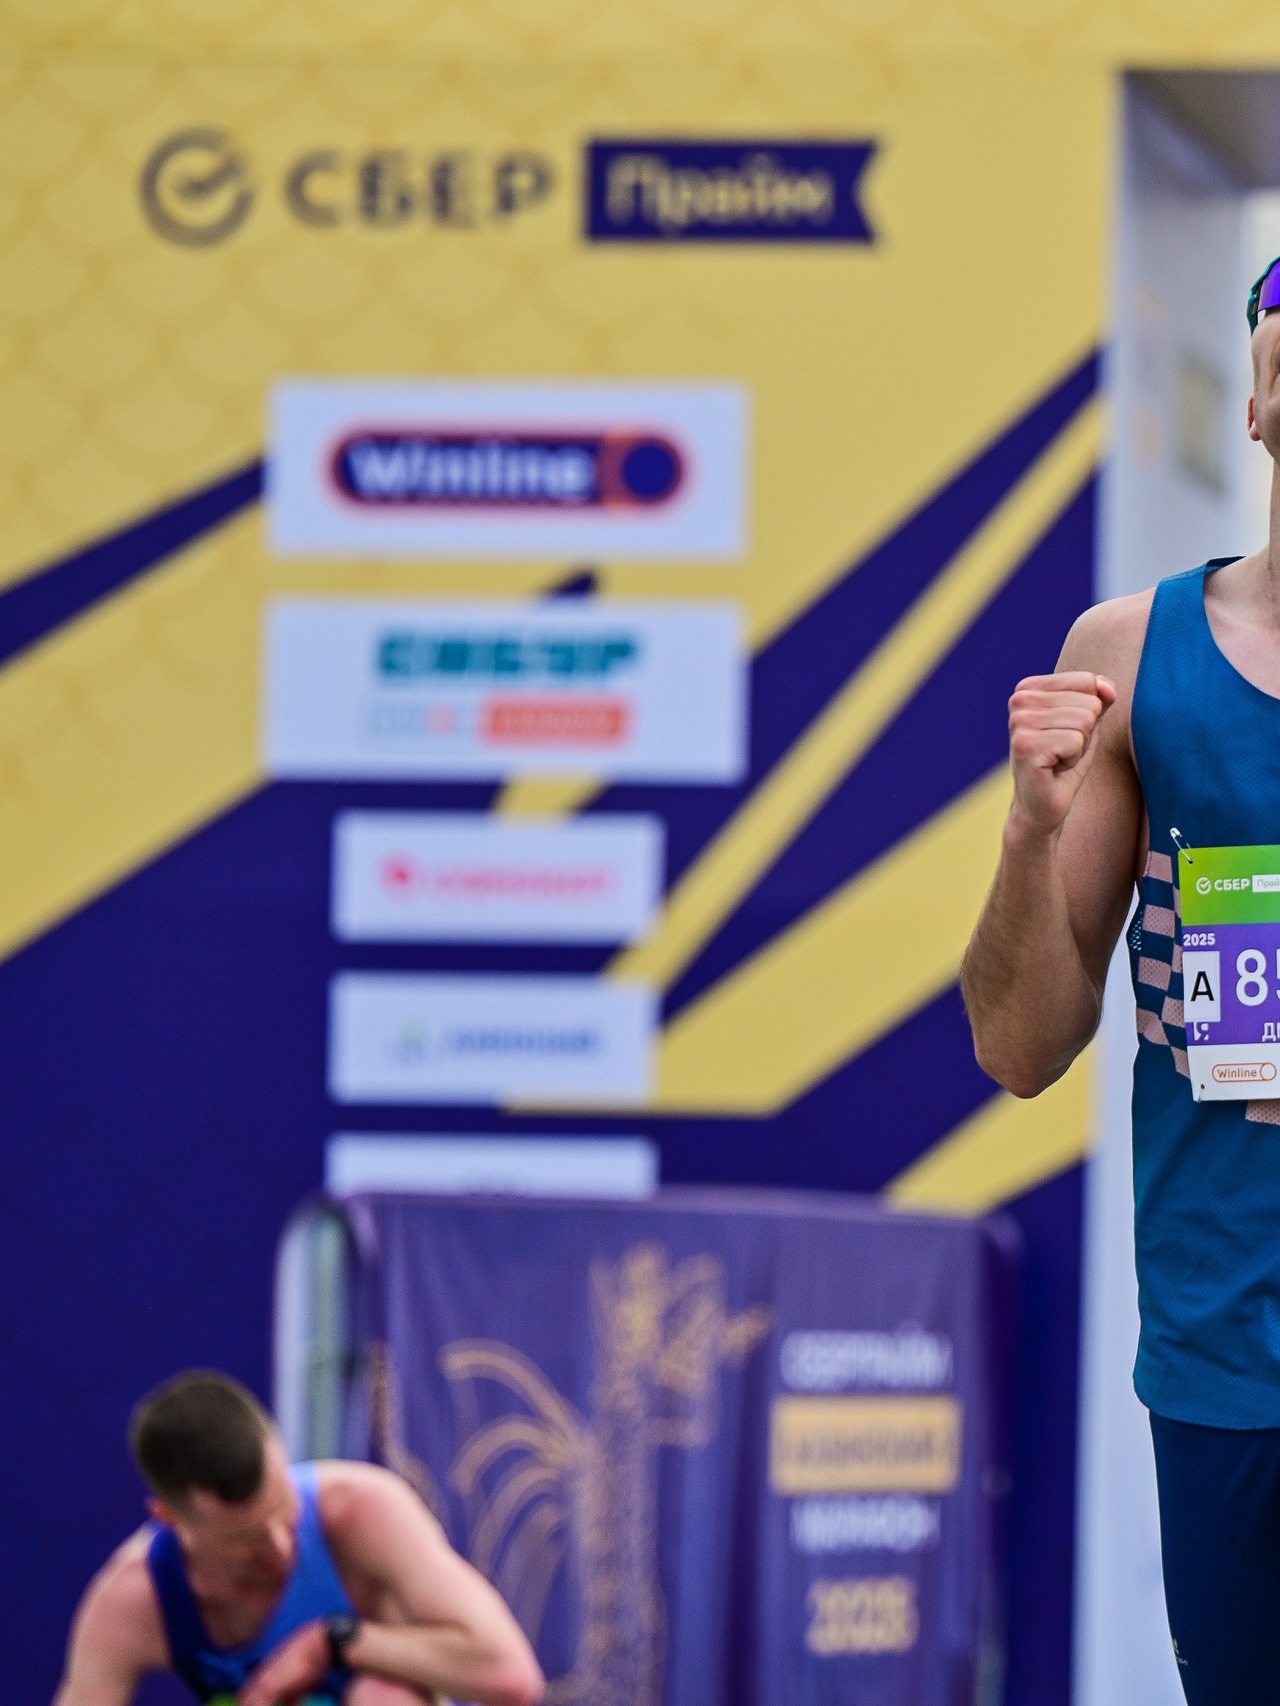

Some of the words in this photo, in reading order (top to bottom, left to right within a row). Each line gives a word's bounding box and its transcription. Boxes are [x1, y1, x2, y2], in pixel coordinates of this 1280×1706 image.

[283, 149, 556, 229] СБЕР
[604, 151, 834, 238] Прайм
[348, 441, 596, 499] Winline
[1213, 878, 1250, 891] СБЕР
[1182, 933, 1216, 947] 2025
[1217, 1067, 1257, 1079] Winline
